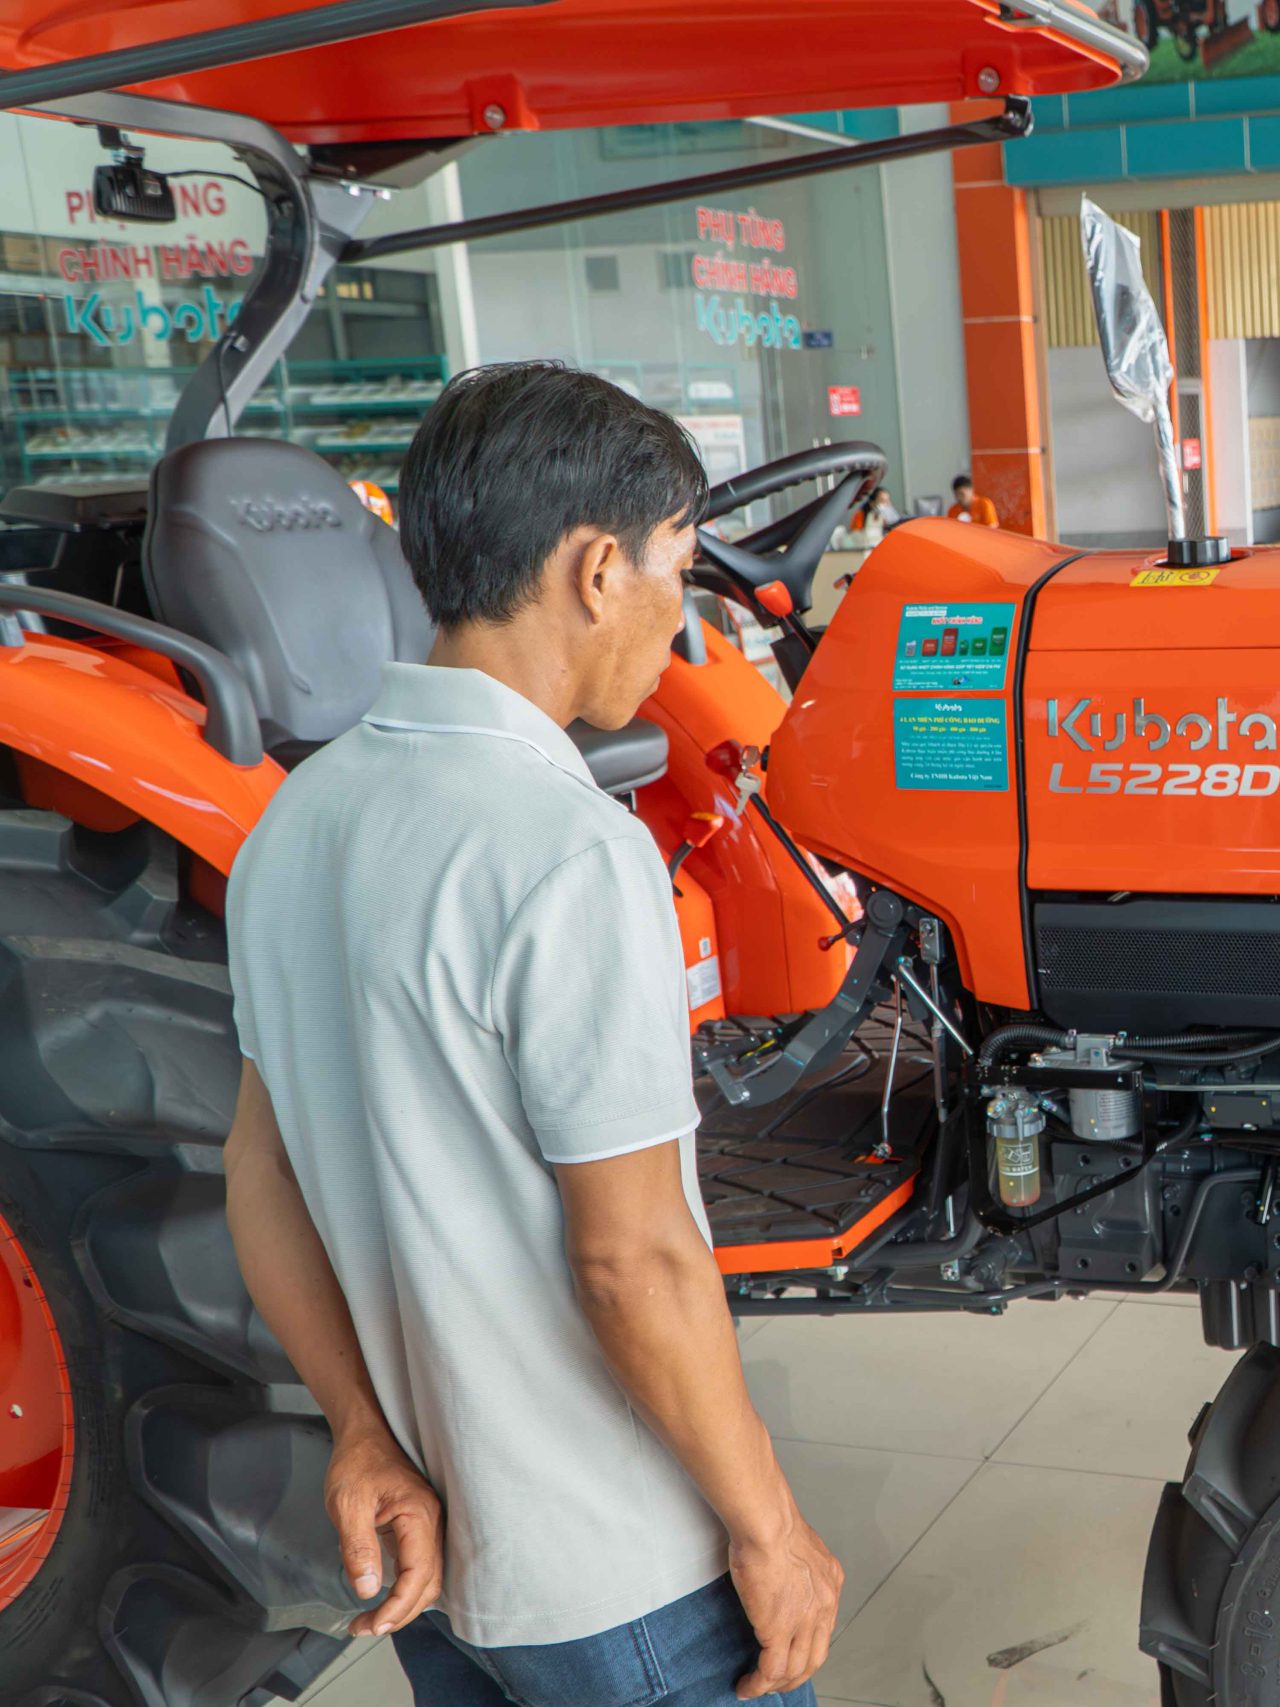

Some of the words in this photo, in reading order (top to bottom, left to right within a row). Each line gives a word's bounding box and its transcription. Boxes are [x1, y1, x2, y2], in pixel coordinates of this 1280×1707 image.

[58, 238, 154, 282] CHÍNH
[695, 293, 800, 349] Kubota
[1047, 697, 1277, 751] Kubota
